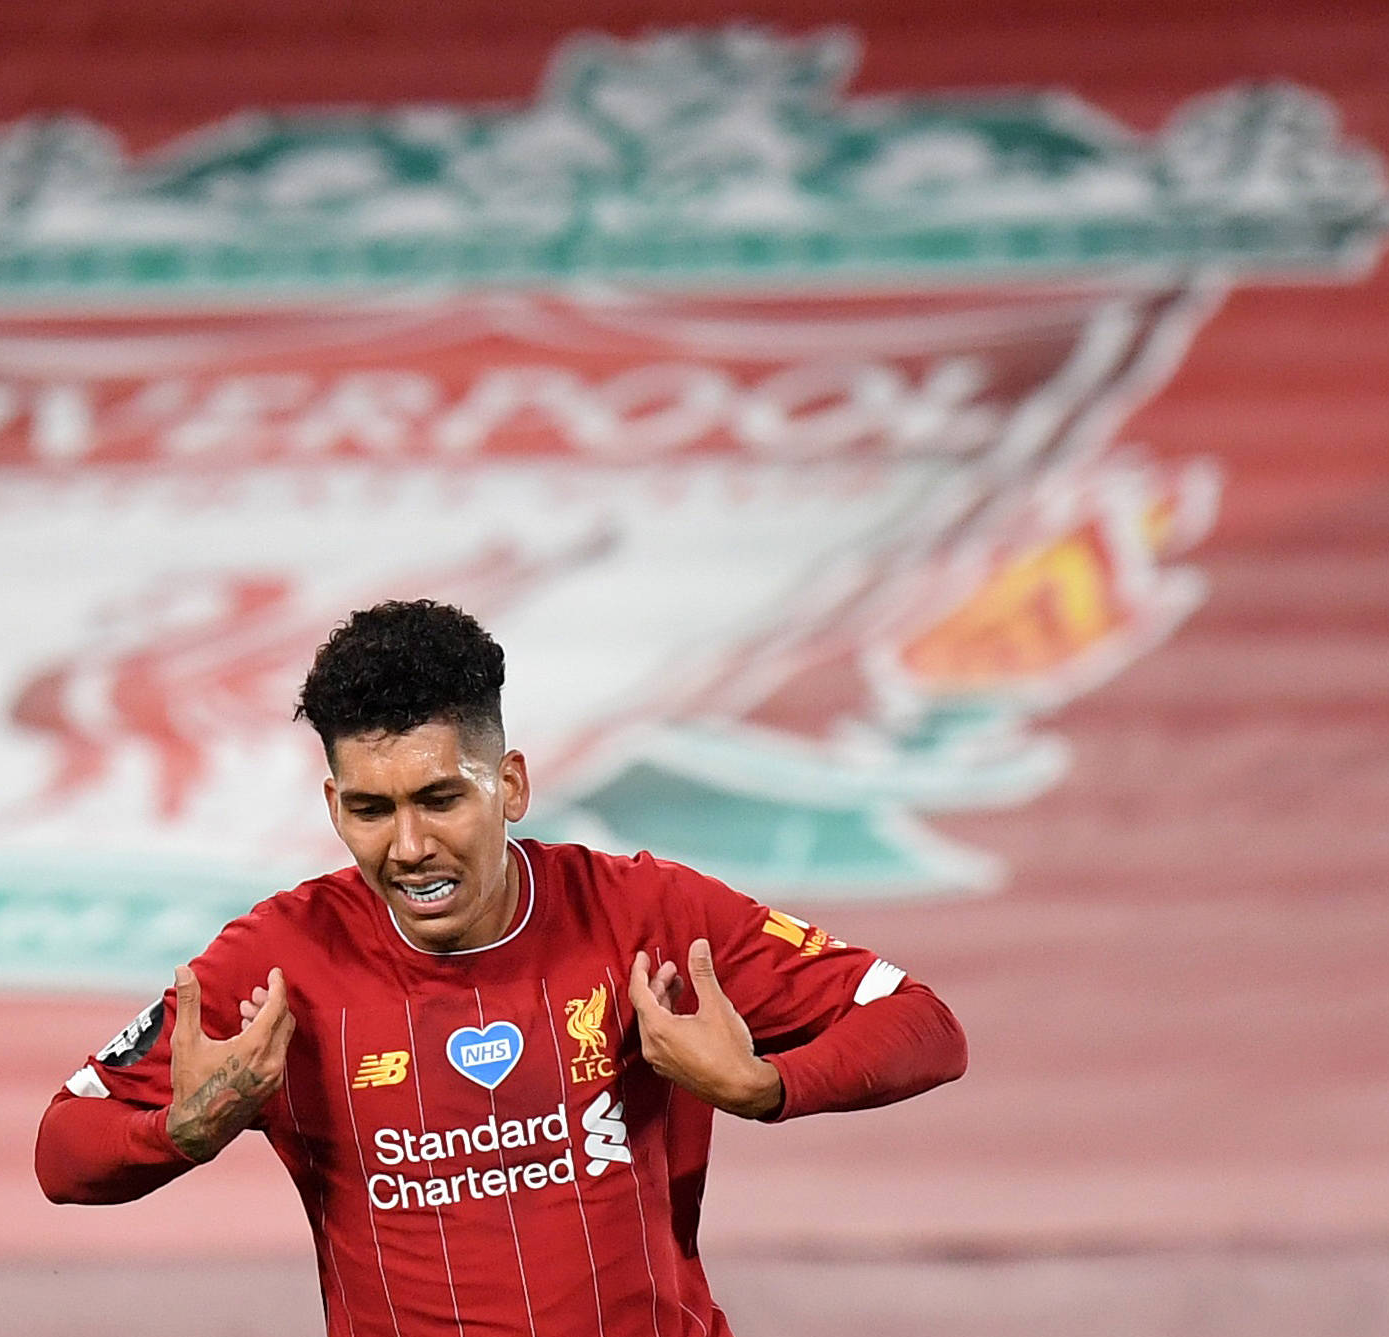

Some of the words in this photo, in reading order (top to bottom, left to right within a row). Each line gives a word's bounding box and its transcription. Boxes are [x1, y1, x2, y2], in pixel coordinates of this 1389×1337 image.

[464, 1040, 508, 1064] NHS
[373, 1103, 570, 1166] Standard
[367, 1148, 577, 1211] Chartered
